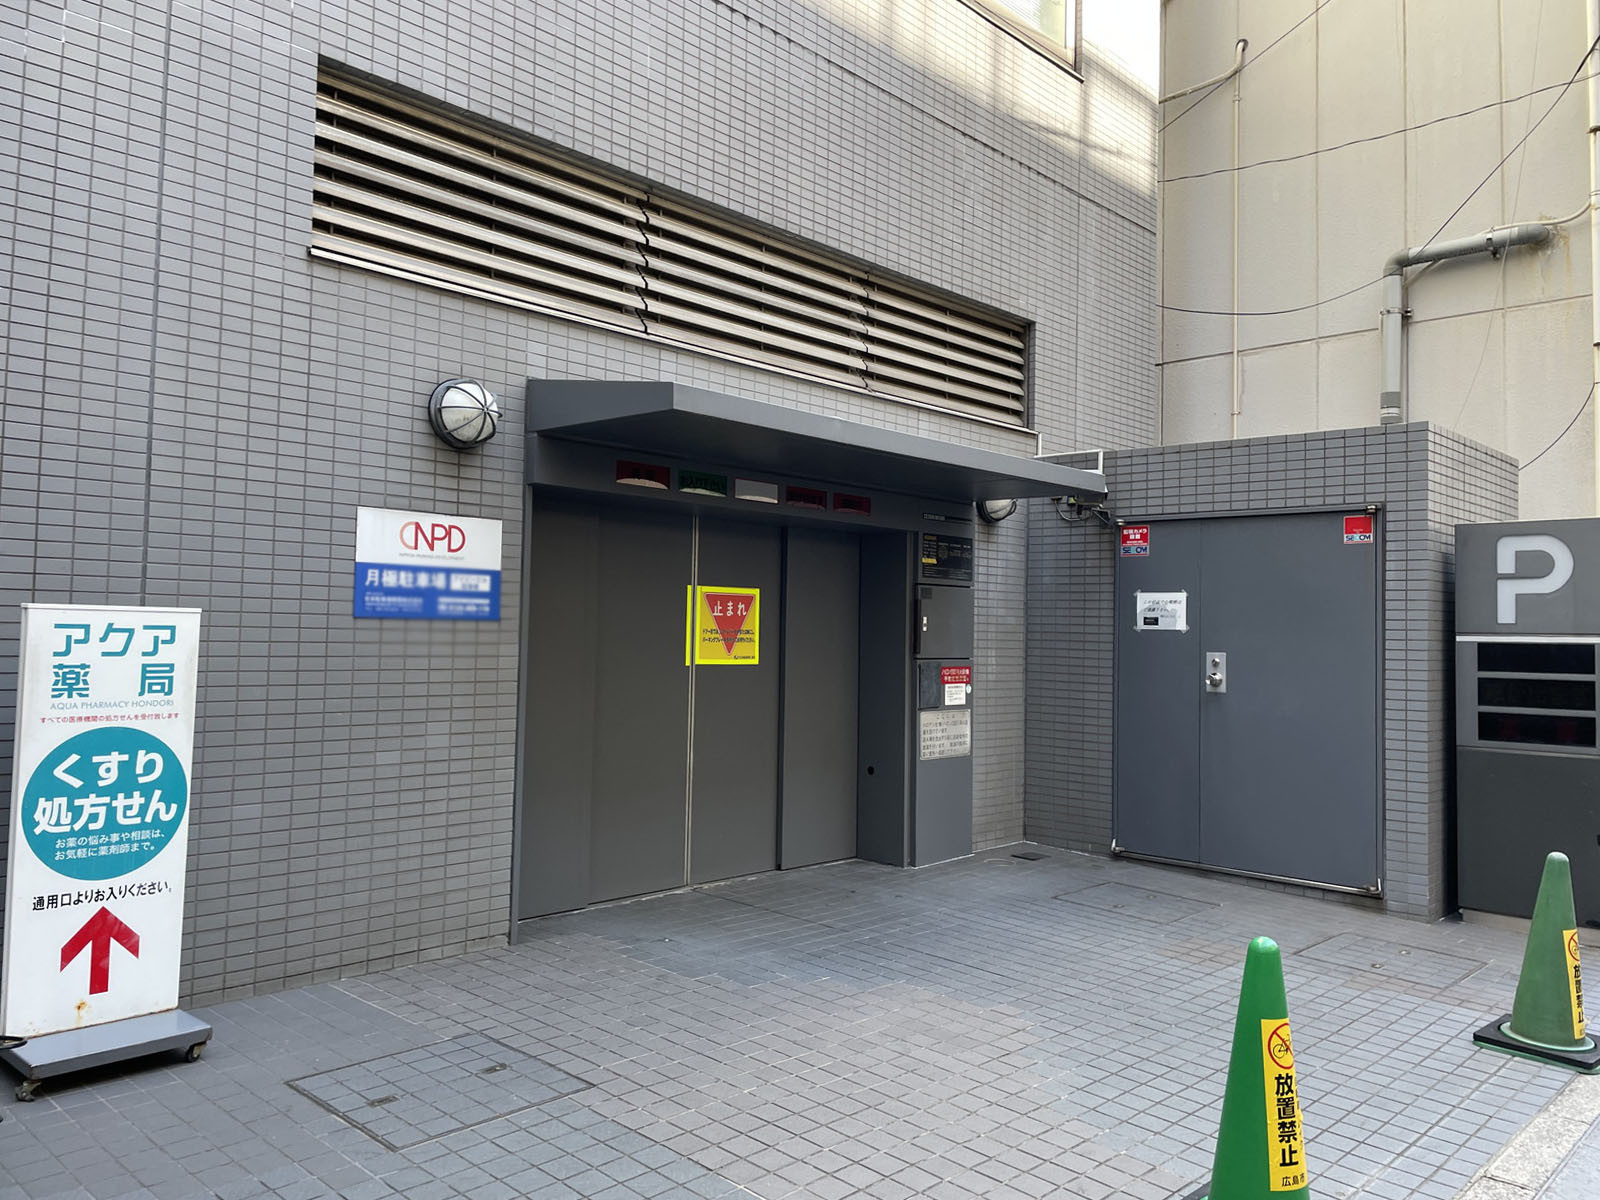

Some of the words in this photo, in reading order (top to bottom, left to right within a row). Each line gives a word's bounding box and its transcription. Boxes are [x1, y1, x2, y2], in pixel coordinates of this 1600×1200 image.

[1496, 534, 1574, 624] P
[712, 600, 747, 616] 止まれ
[52, 622, 177, 657] アクア
[51, 663, 175, 699] 薬局
[50, 702, 78, 711] AQUA
[80, 700, 130, 710] PHARMACY
[131, 699, 174, 708] HONDORI
[53, 750, 163, 789] くすり
[33, 789, 178, 836] 処方せん
[54, 842, 155, 861] お気軽に薬剤師まで。
[55, 828, 165, 849] お薬の悩み事や相談は、
[32, 881, 172, 911] 通用口よりお入りください。
[1274, 1072, 1300, 1168] 放置禁止
